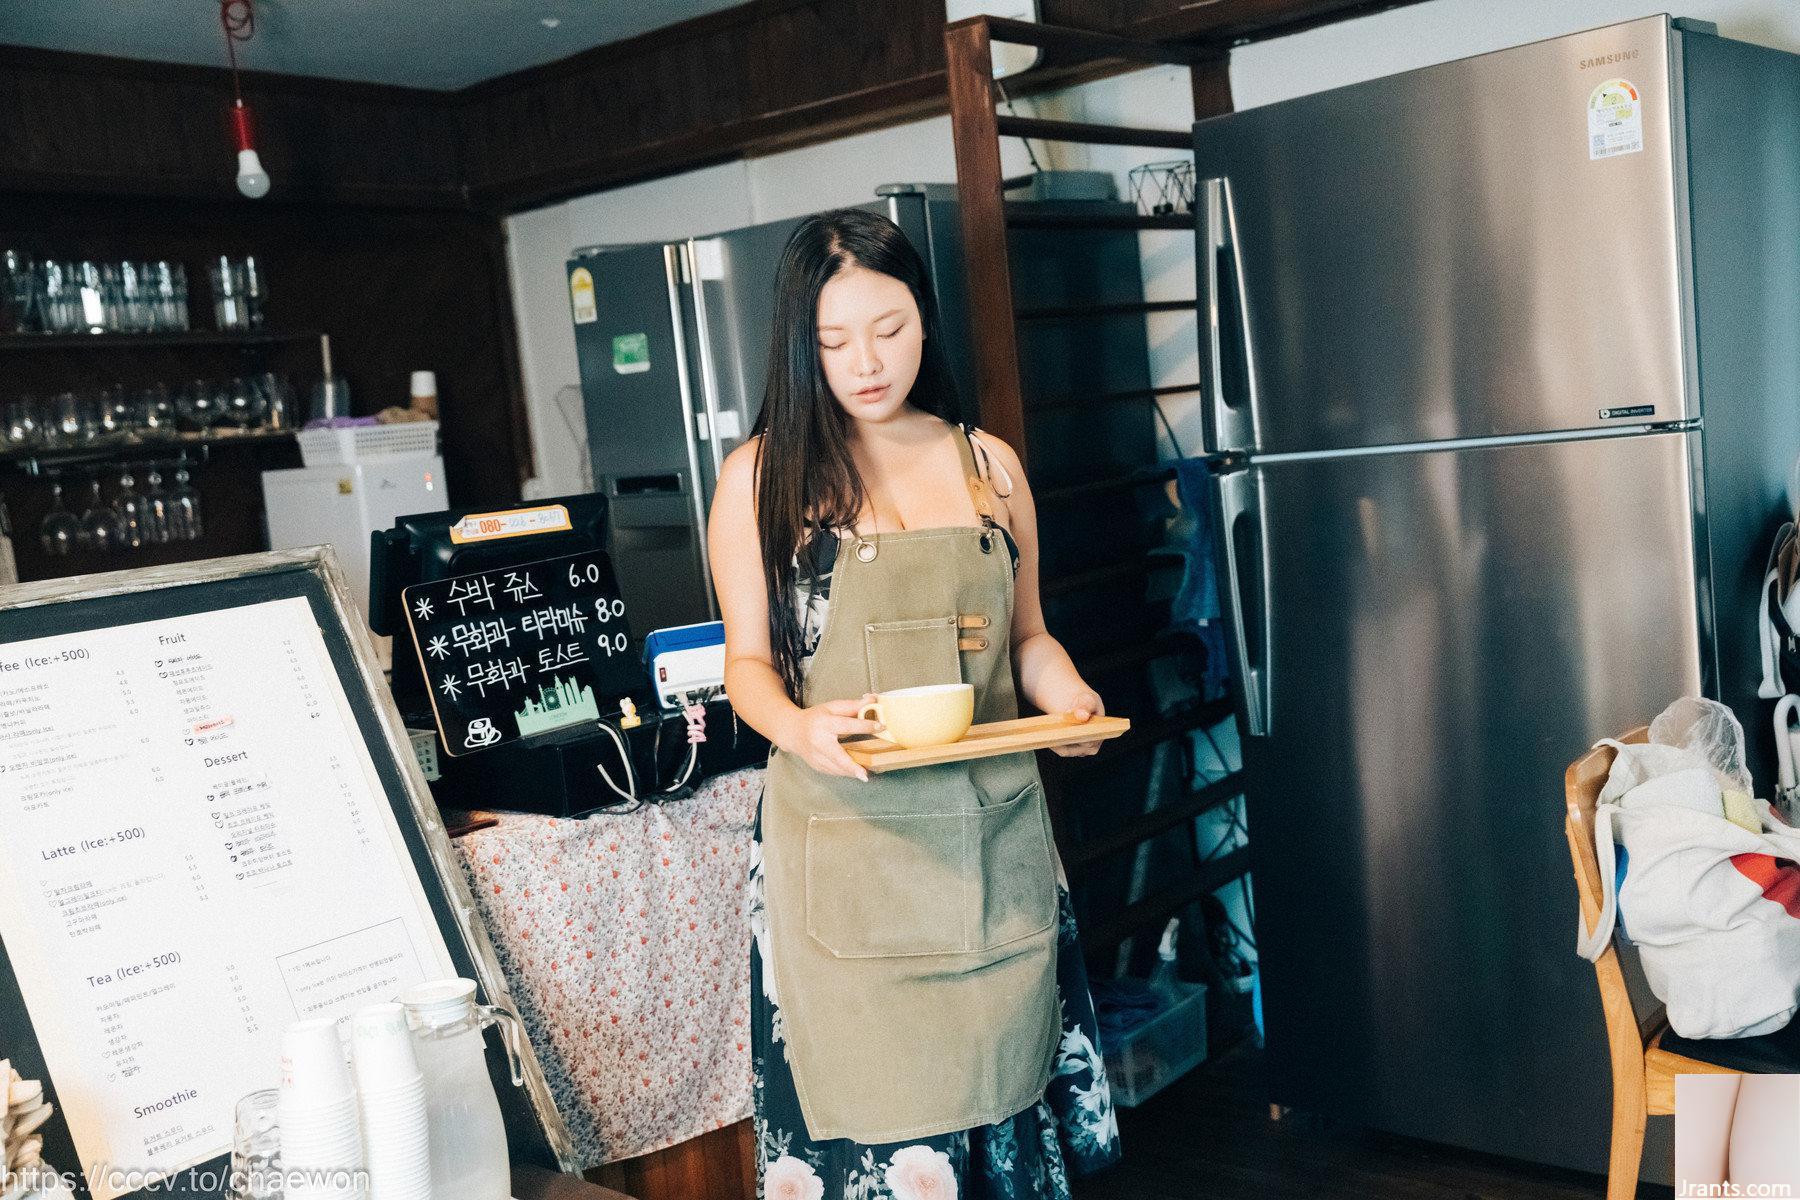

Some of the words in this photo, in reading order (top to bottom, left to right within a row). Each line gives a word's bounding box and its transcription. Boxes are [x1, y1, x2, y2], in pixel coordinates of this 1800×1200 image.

[1580, 49, 1639, 70] SAMSUNG
[446, 575, 496, 616] 수박
[502, 572, 543, 604] 쥬스
[568, 563, 599, 588] 6.0
[158, 632, 186, 646] Fruit
[451, 617, 516, 658] 무화과
[594, 597, 625, 623] 8.0
[24, 648, 90, 669] (Ice:+500)
[467, 656, 531, 698] 무화과
[538, 642, 590, 673] 토스트
[597, 632, 627, 658] 9.0
[204, 750, 248, 768] Dessert
[41, 844, 76, 861] Latte
[80, 827, 146, 853] (Ice:+500)
[87, 972, 113, 988] Tea
[116, 951, 182, 981] (Ice:+500)
[134, 1089, 198, 1119] Smoothie
